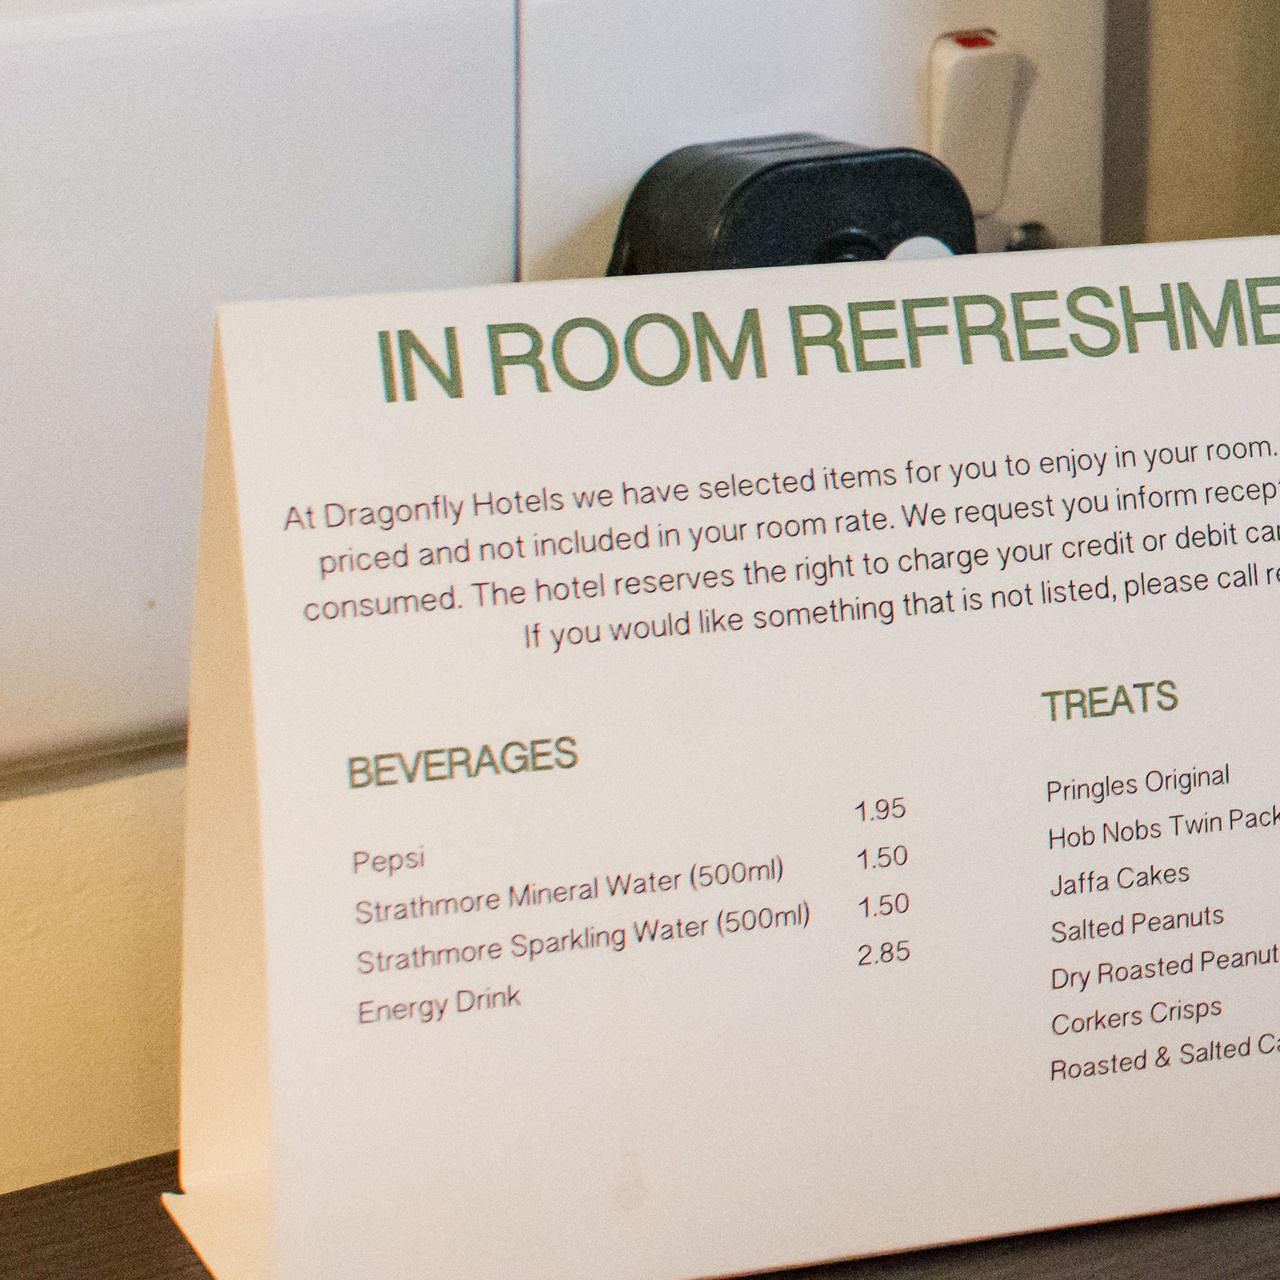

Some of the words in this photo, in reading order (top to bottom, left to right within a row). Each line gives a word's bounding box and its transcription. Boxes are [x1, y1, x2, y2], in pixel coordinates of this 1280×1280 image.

[377, 325, 465, 404] IN
[485, 307, 769, 397] ROOM
[283, 505, 317, 532] At
[323, 494, 465, 532] Dragonfly
[471, 486, 566, 517] Hotels
[571, 488, 615, 510] we
[621, 481, 690, 506] have
[698, 467, 817, 501] selected
[822, 466, 898, 491] items
[904, 459, 943, 485] for
[948, 459, 998, 489] you
[1004, 454, 1032, 478] to
[1038, 447, 1108, 479] enjoy
[1114, 444, 1137, 469] in
[1142, 444, 1199, 474] your
[1205, 439, 1278, 462] room.
[319, 542, 410, 581] priced
[418, 537, 472, 567] and
[478, 535, 526, 562] not
[533, 523, 651, 558] included
[658, 527, 682, 548] in
[687, 522, 748, 553] your
[756, 516, 828, 540] room
[834, 508, 895, 534] rate.
[900, 501, 947, 529] We
[954, 494, 1056, 528] request
[1061, 494, 1110, 523] you
[1115, 484, 1198, 512] inform
[303, 584, 464, 622] consumed.
[470, 580, 527, 608] The
[534, 572, 606, 603] hotel
[613, 568, 736, 597] reserves
[742, 559, 788, 586] the
[794, 553, 856, 587] right
[862, 552, 890, 576] to
[897, 546, 990, 576] charge
[996, 542, 1054, 572] your
[1061, 529, 1135, 560] credit
[1141, 532, 1168, 553] or
[1174, 521, 1239, 550] debit
[524, 622, 542, 649] If
[549, 624, 602, 655] you
[608, 609, 692, 642] would
[698, 607, 744, 635] like
[752, 595, 896, 630] something
[902, 589, 956, 617] that
[961, 586, 984, 612] is
[990, 582, 1034, 610] not
[1040, 574, 1118, 605] listed,
[1123, 571, 1210, 605] please
[1216, 561, 1259, 590] call
[1040, 678, 1180, 723] TREATS
[347, 735, 580, 790] BEVERAGES
[1046, 774, 1139, 805] Pringles
[1144, 762, 1230, 796] Original
[854, 796, 907, 823] 1.95
[1047, 824, 1096, 851] Hob
[1102, 818, 1163, 845] Nobs
[1168, 813, 1223, 837] Twin
[353, 846, 425, 877] Pepsi
[856, 844, 909, 870] 1.50
[355, 892, 502, 925] Strathmore
[508, 876, 600, 908] Mineral
[605, 871, 683, 898] Water
[688, 854, 785, 892] (500ml)
[1049, 869, 1110, 898] Jaffa
[1116, 864, 1191, 890] Cakes
[858, 891, 911, 918] 1.50
[1051, 913, 1125, 944] Salted
[1131, 905, 1225, 935] Peanuts
[357, 942, 503, 975] Strathmore
[510, 926, 628, 962] Sparkling
[632, 918, 710, 944] Water
[715, 899, 811, 938] (500ml)
[857, 939, 911, 967] 2.85
[1051, 967, 1092, 993] Dry
[1097, 952, 1194, 985] Roasted
[358, 997, 449, 1025] Energy
[456, 984, 522, 1014] Drink
[1050, 1008, 1144, 1037] Corkers
[1149, 999, 1223, 1025] Crisps
[1050, 1048, 1148, 1082] Roasted
[1154, 1045, 1172, 1069] &
[1179, 1035, 1252, 1066] Salted
